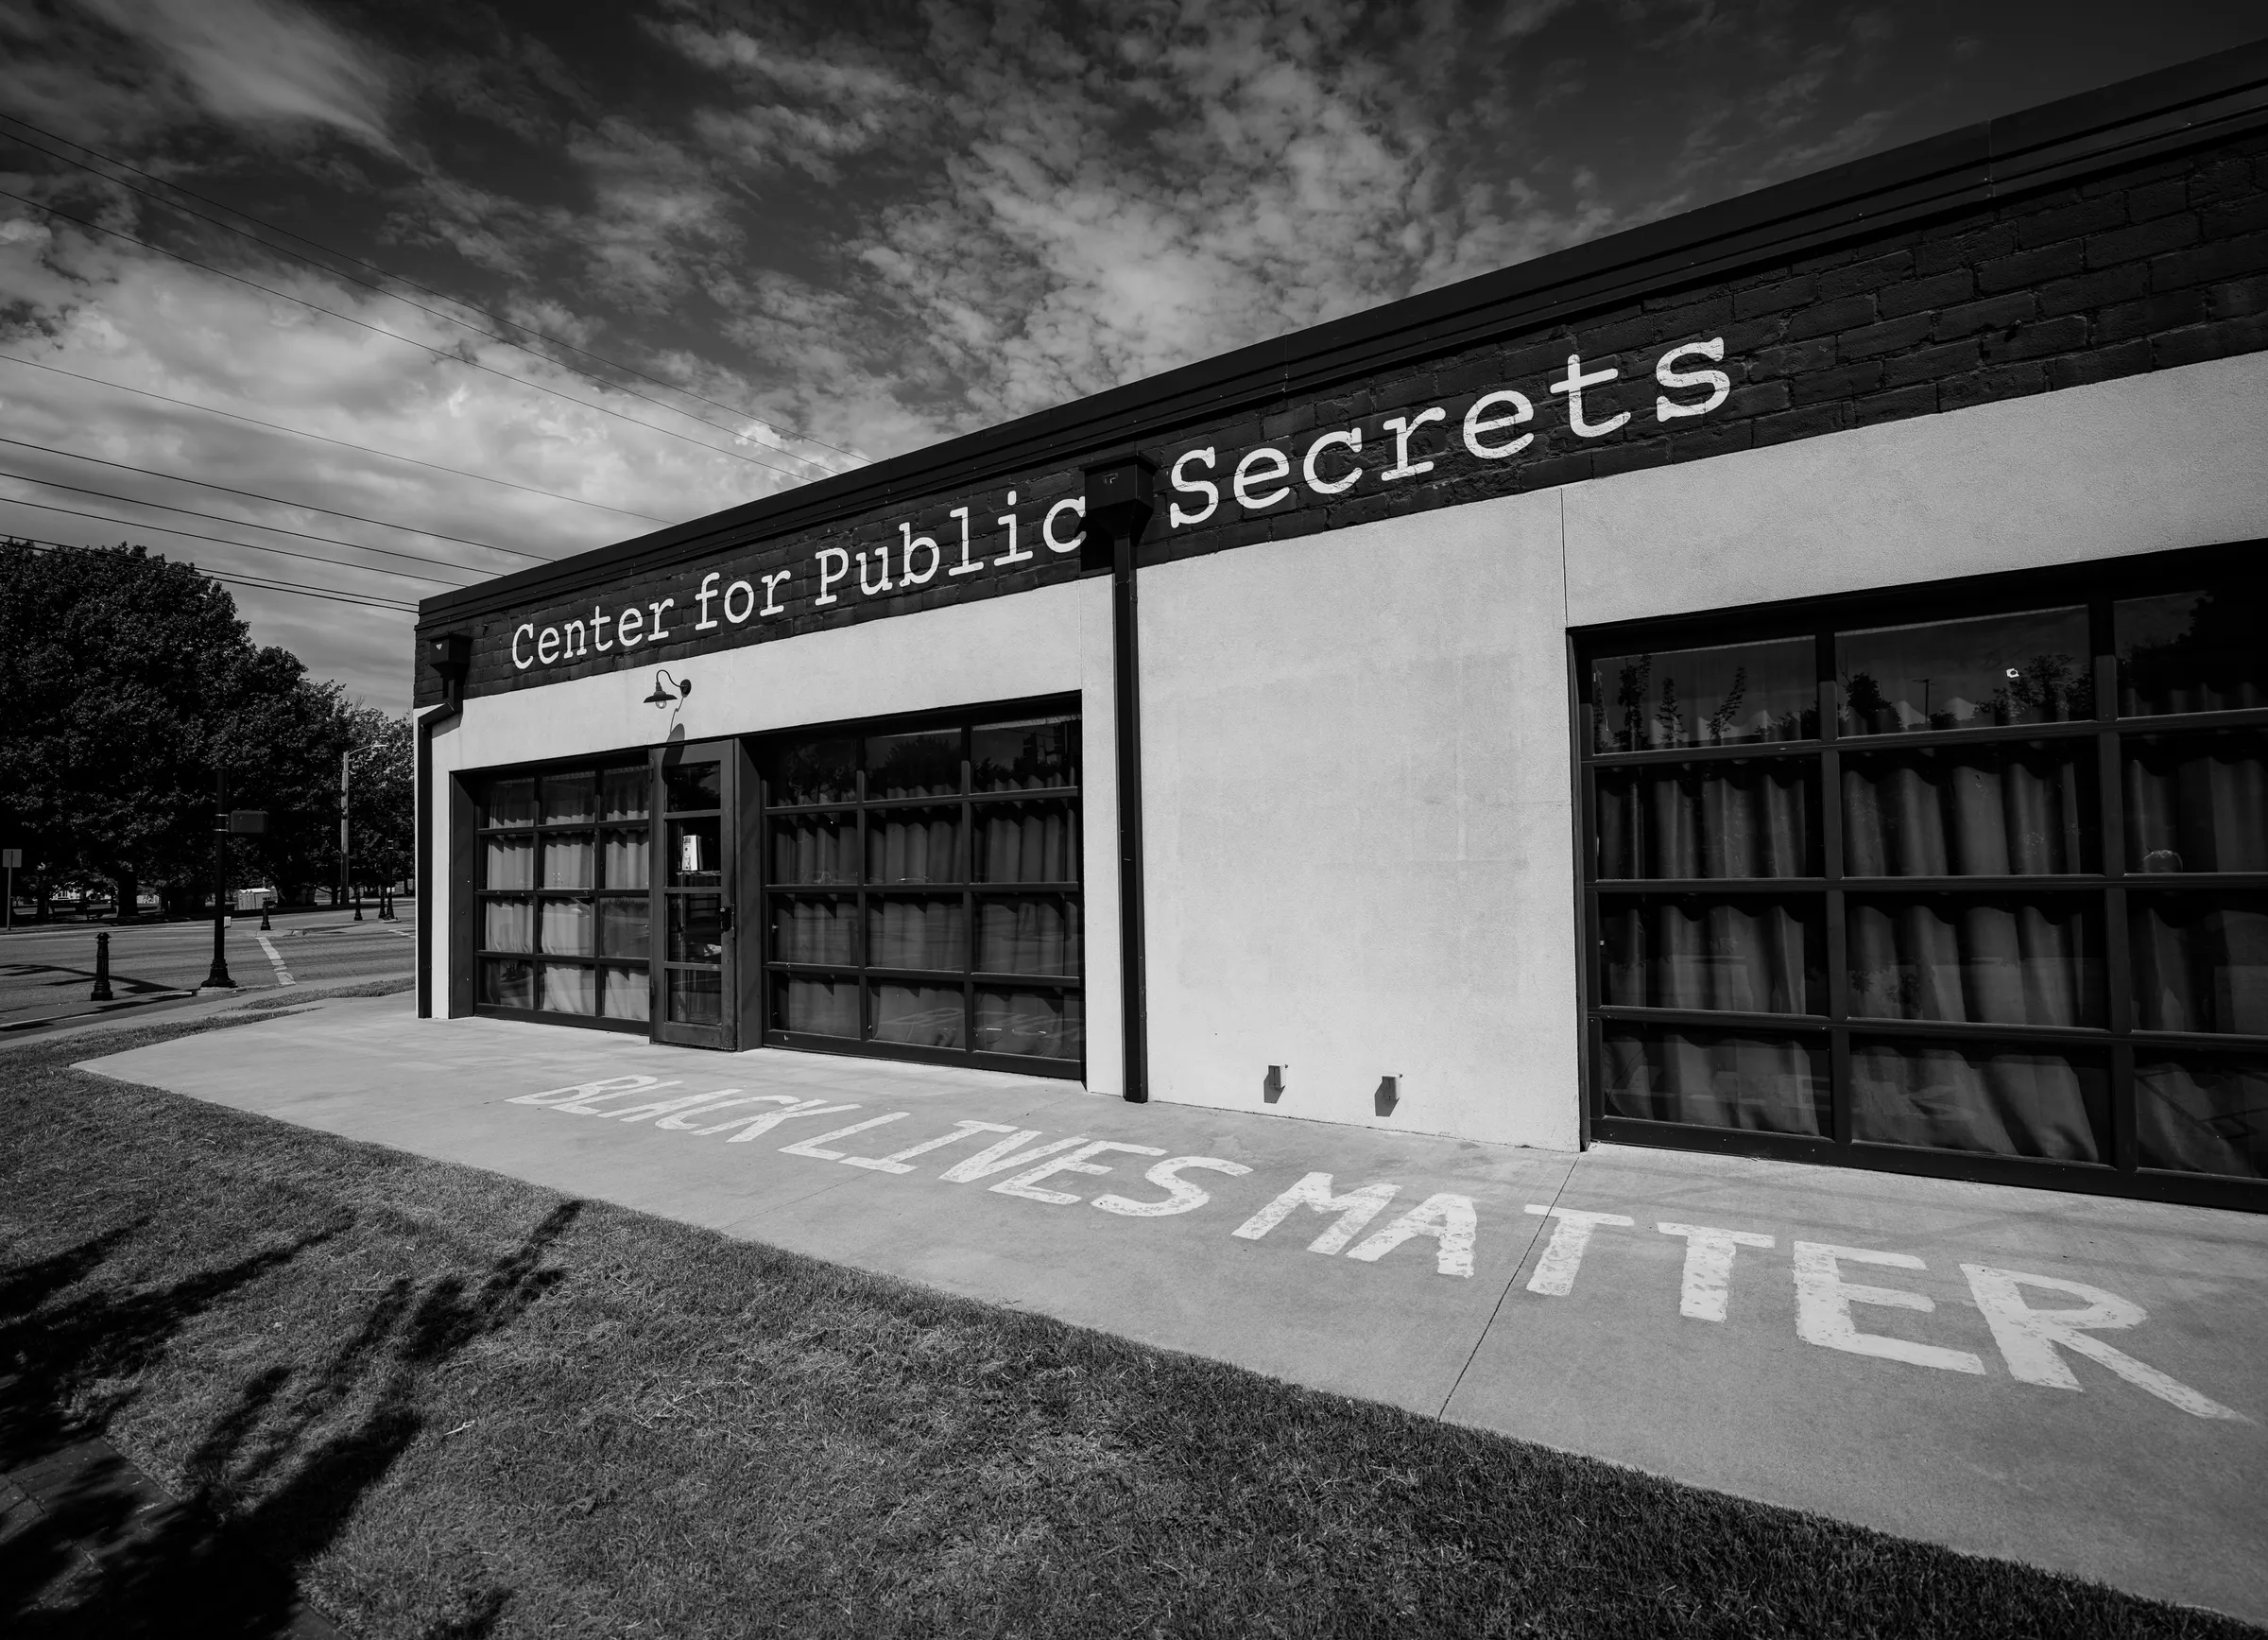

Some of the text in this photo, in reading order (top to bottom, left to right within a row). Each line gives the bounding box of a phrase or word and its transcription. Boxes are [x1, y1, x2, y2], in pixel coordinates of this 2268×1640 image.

[511, 337, 1731, 669] Center for Public Secrets
[505, 1075, 2249, 1424] BLACK LIVES MATTER
